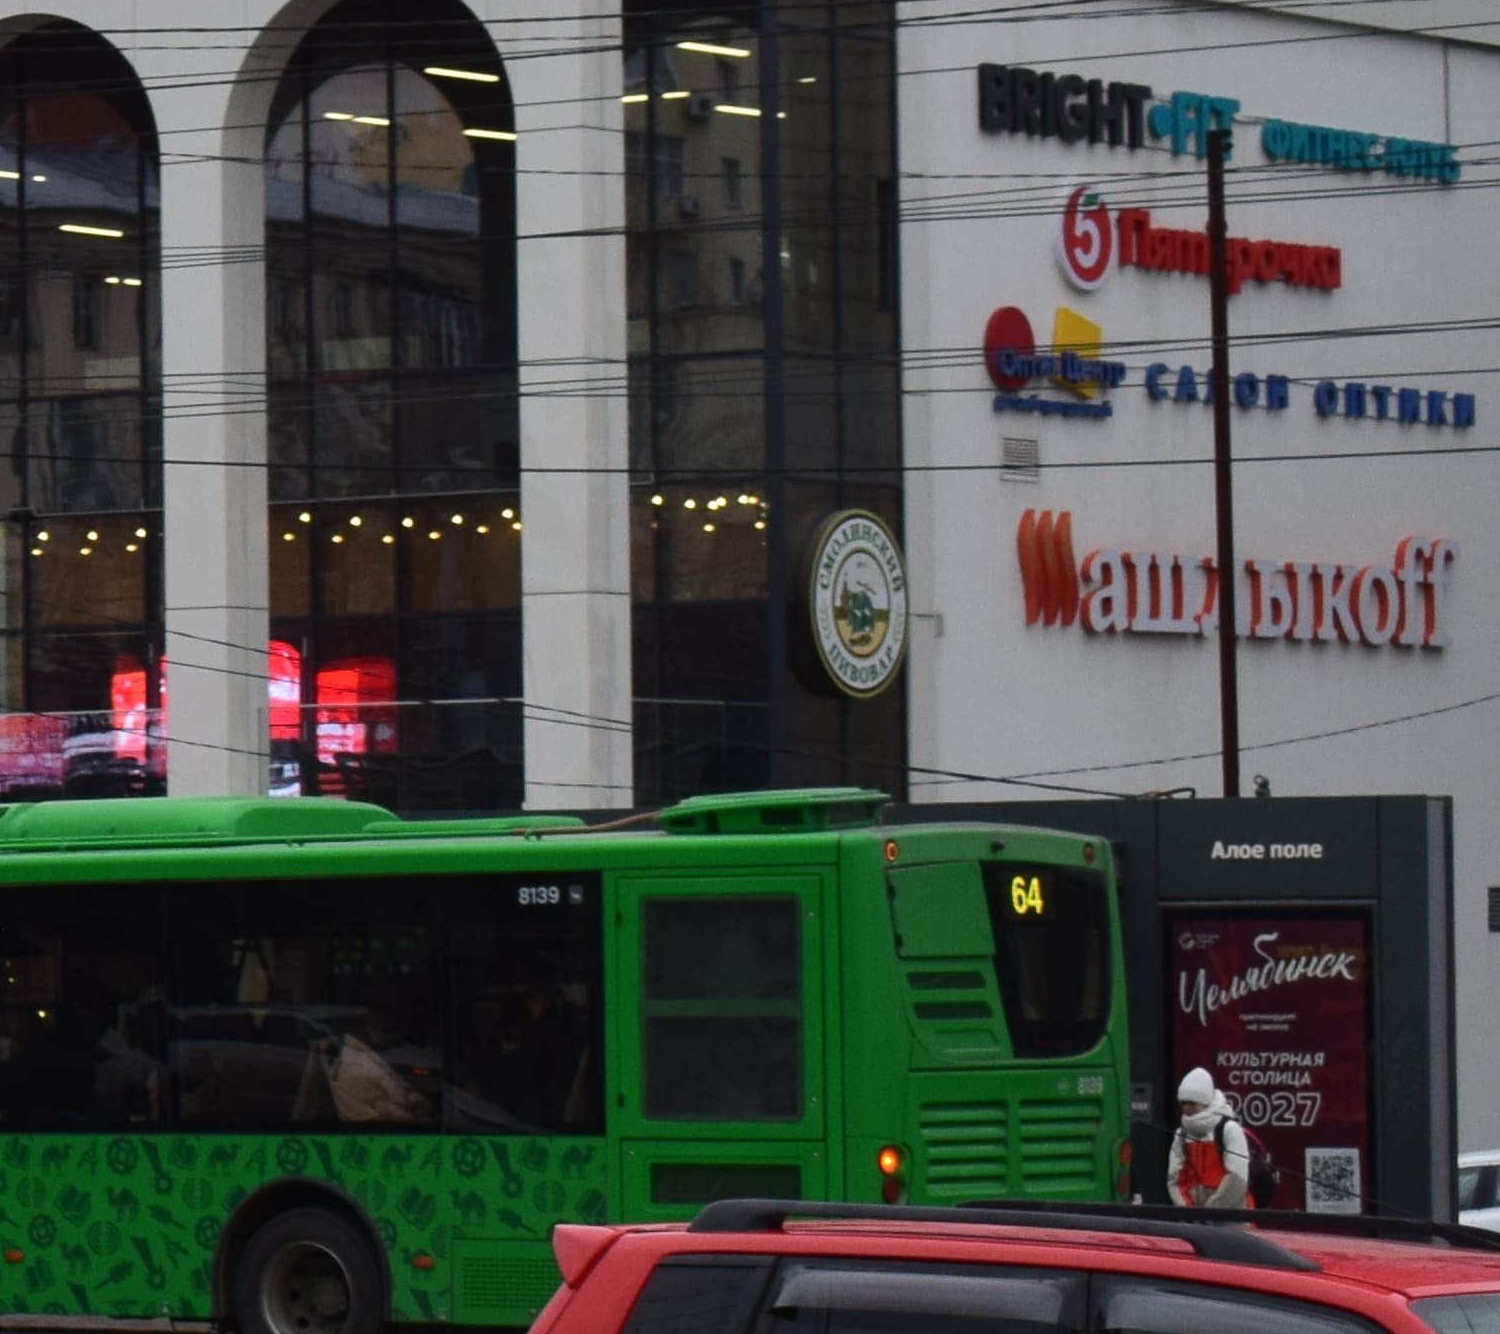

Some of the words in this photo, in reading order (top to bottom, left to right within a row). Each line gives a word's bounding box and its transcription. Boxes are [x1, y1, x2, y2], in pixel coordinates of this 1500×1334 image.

[1118, 208, 1342, 296] Пятрочка
[1314, 380, 1475, 427] ОПТИКИ
[1211, 840, 1265, 859] Алое
[1269, 843, 1323, 859] поле
[518, 886, 560, 905] 8139
[1012, 876, 1043, 914] 64
[1179, 932, 1357, 1027] Челябинск
[1216, 1052, 1325, 1067] КУЛЬТУРНАЯ
[1228, 1071, 1312, 1087] СТОЛИЦА
